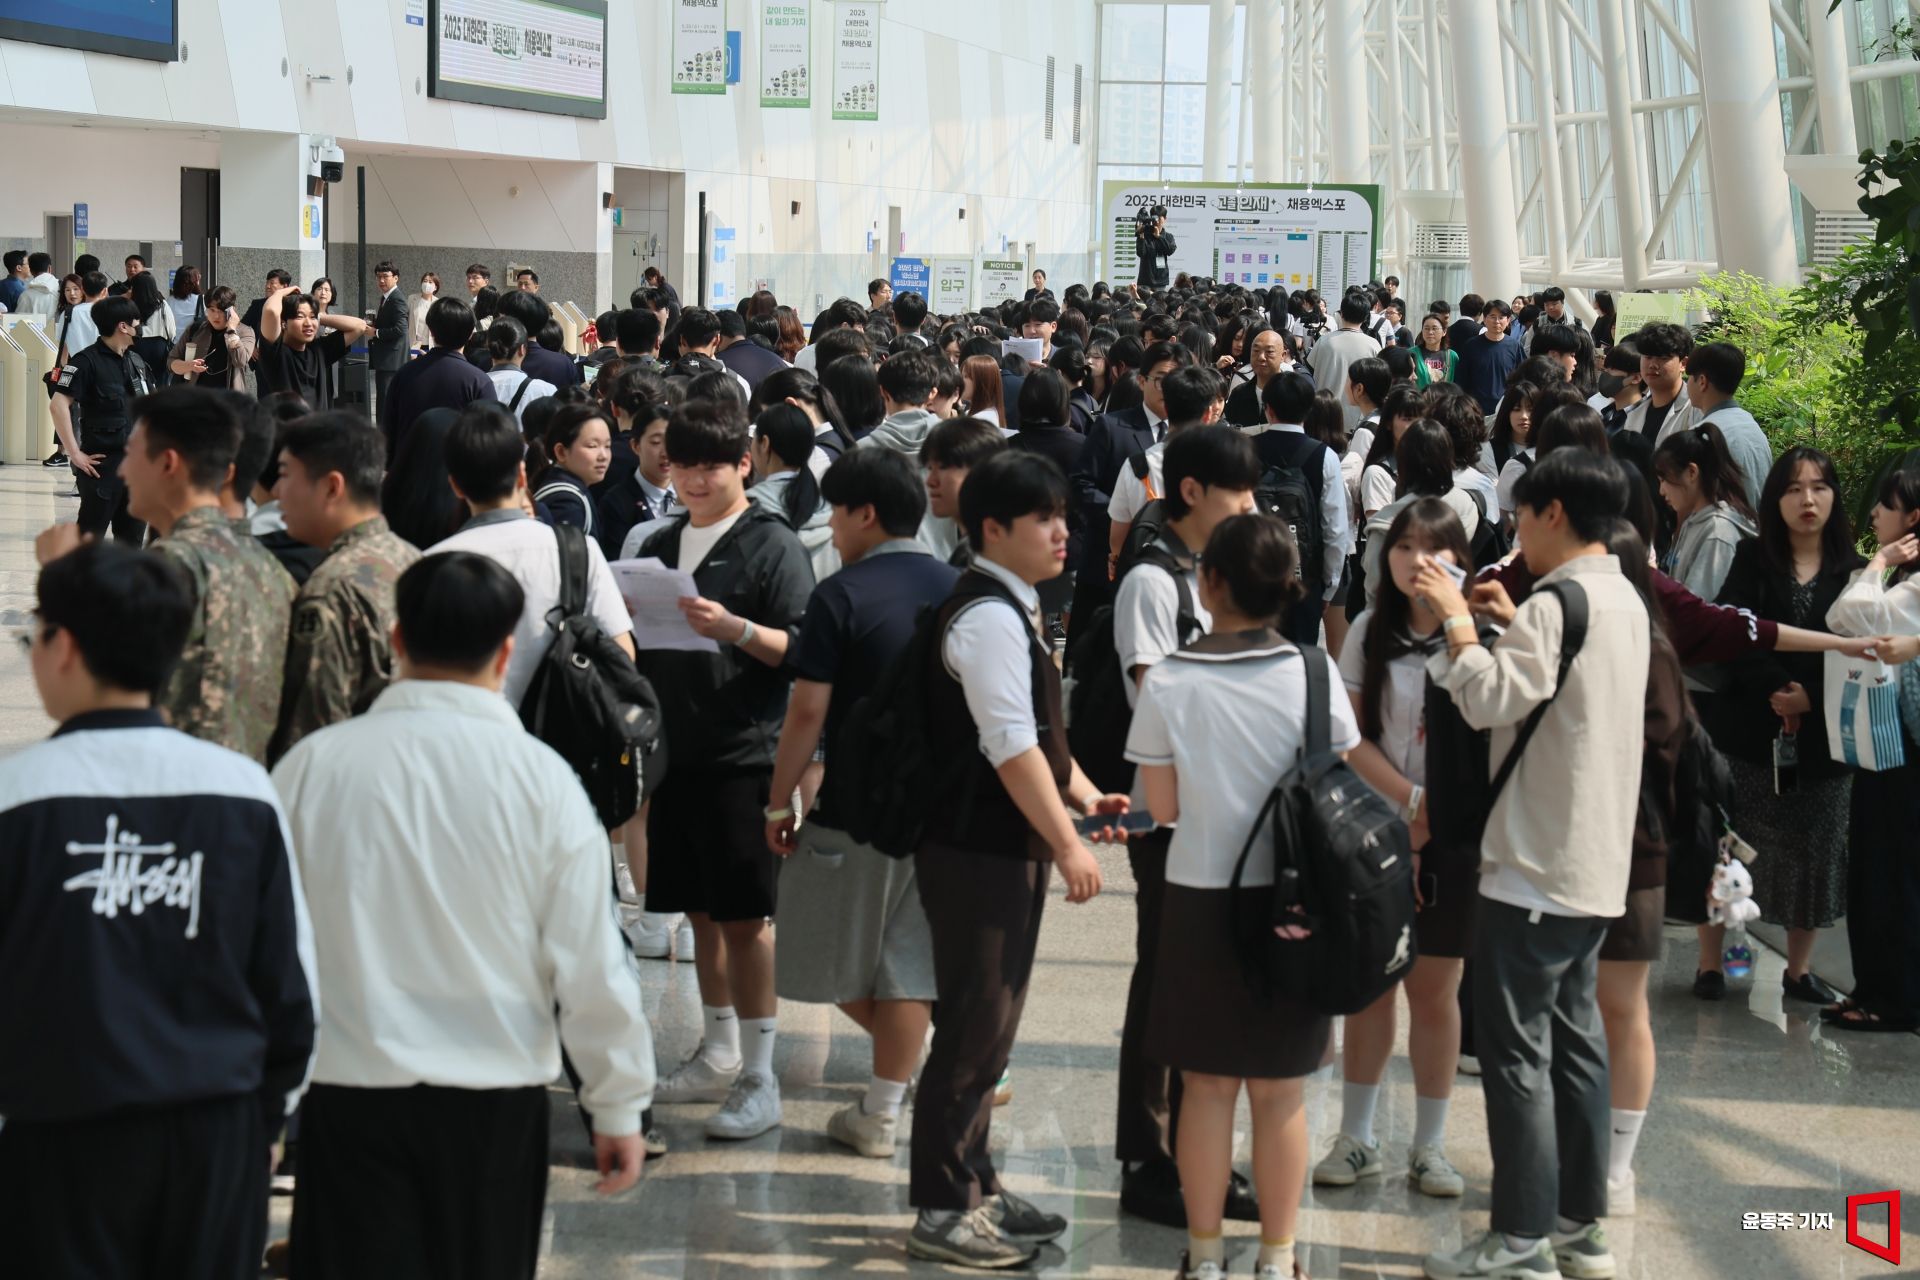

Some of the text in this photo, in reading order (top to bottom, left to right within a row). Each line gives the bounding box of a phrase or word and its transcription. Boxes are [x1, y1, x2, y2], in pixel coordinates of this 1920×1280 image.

[766, 6, 805, 15] 같이 만드는
[849, 9, 866, 17] 2025
[791, 17, 806, 26] 가치
[444, 14, 461, 40] 2025
[463, 16, 488, 46] 대한민국
[524, 28, 552, 58] 채용엑스포
[841, 39, 873, 48] 채용엑스포
[1125, 194, 1157, 207] 2025
[1160, 194, 1207, 208] 대한민국
[1287, 197, 1346, 211] 채용엑스포
[940, 278, 965, 293] 입구
